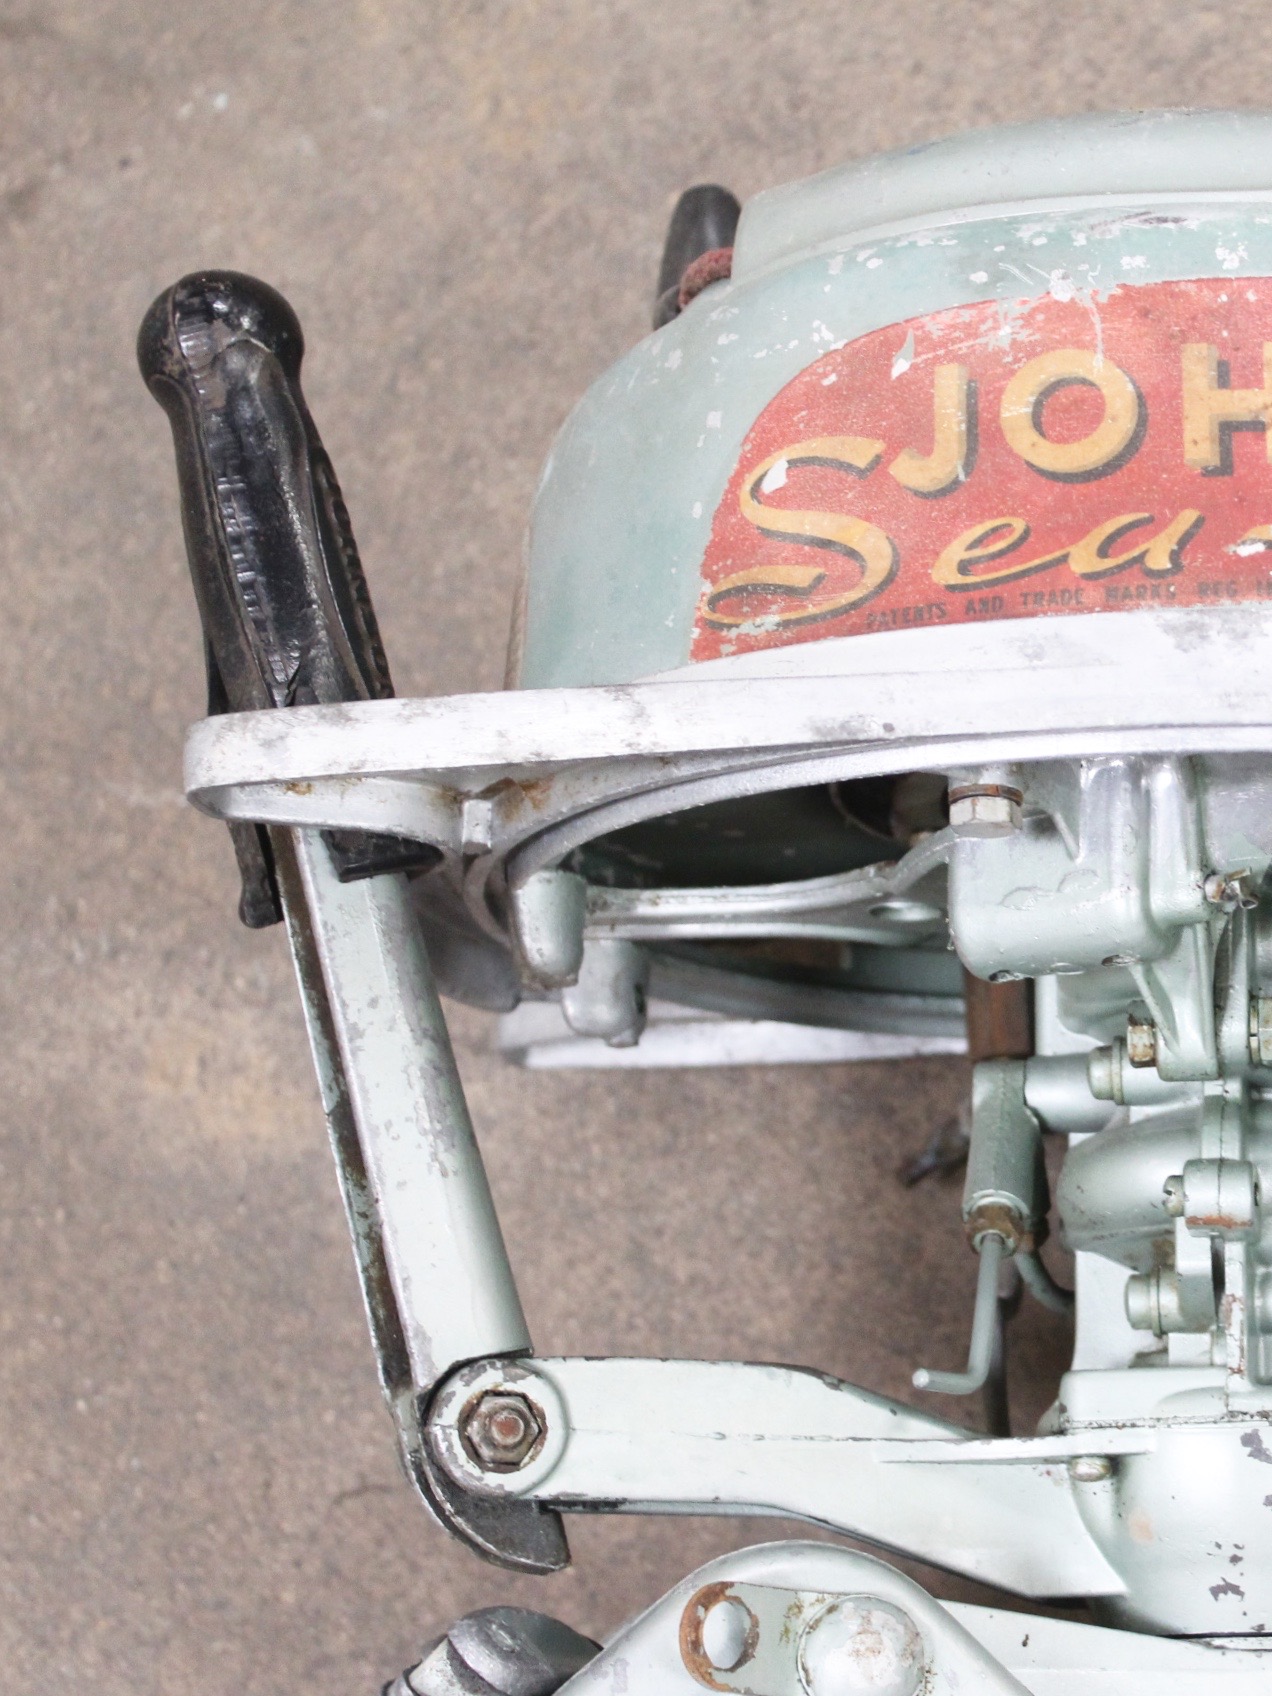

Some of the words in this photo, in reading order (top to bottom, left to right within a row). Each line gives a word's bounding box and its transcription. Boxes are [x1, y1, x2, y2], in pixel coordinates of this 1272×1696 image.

[866, 601, 948, 628] PATENTS
[965, 595, 1005, 615] AND
[1020, 587, 1084, 609] TRADE
[1105, 583, 1177, 603] MARKS
